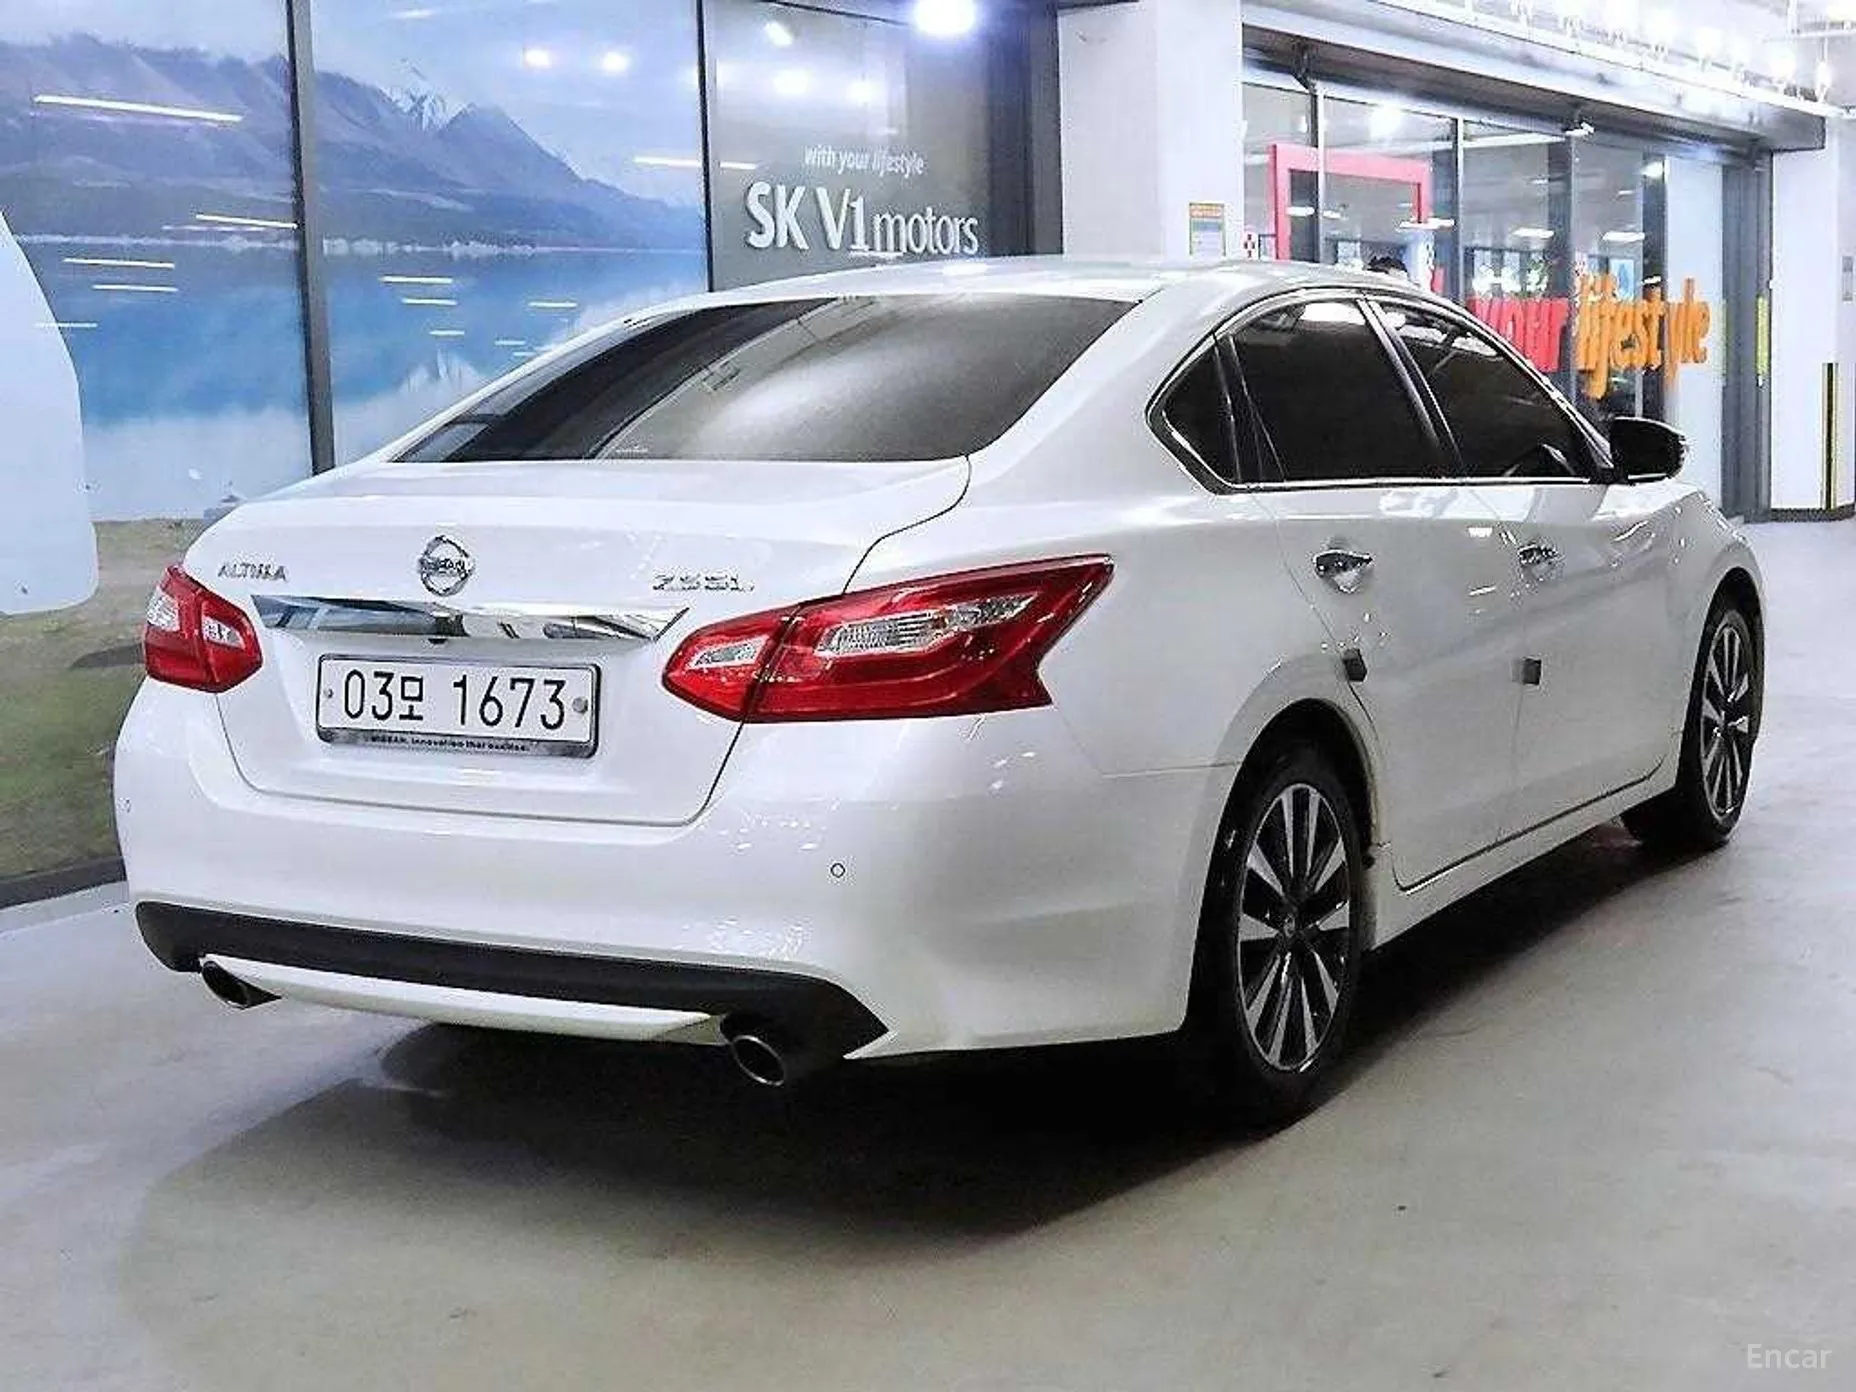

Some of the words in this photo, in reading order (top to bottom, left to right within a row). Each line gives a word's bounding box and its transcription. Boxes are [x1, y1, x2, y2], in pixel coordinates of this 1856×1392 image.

[838, 150, 870, 175] your
[871, 149, 925, 179] lifestyle
[745, 180, 809, 250] SK
[343, 669, 424, 721] 03모
[453, 674, 567, 731] 1673
